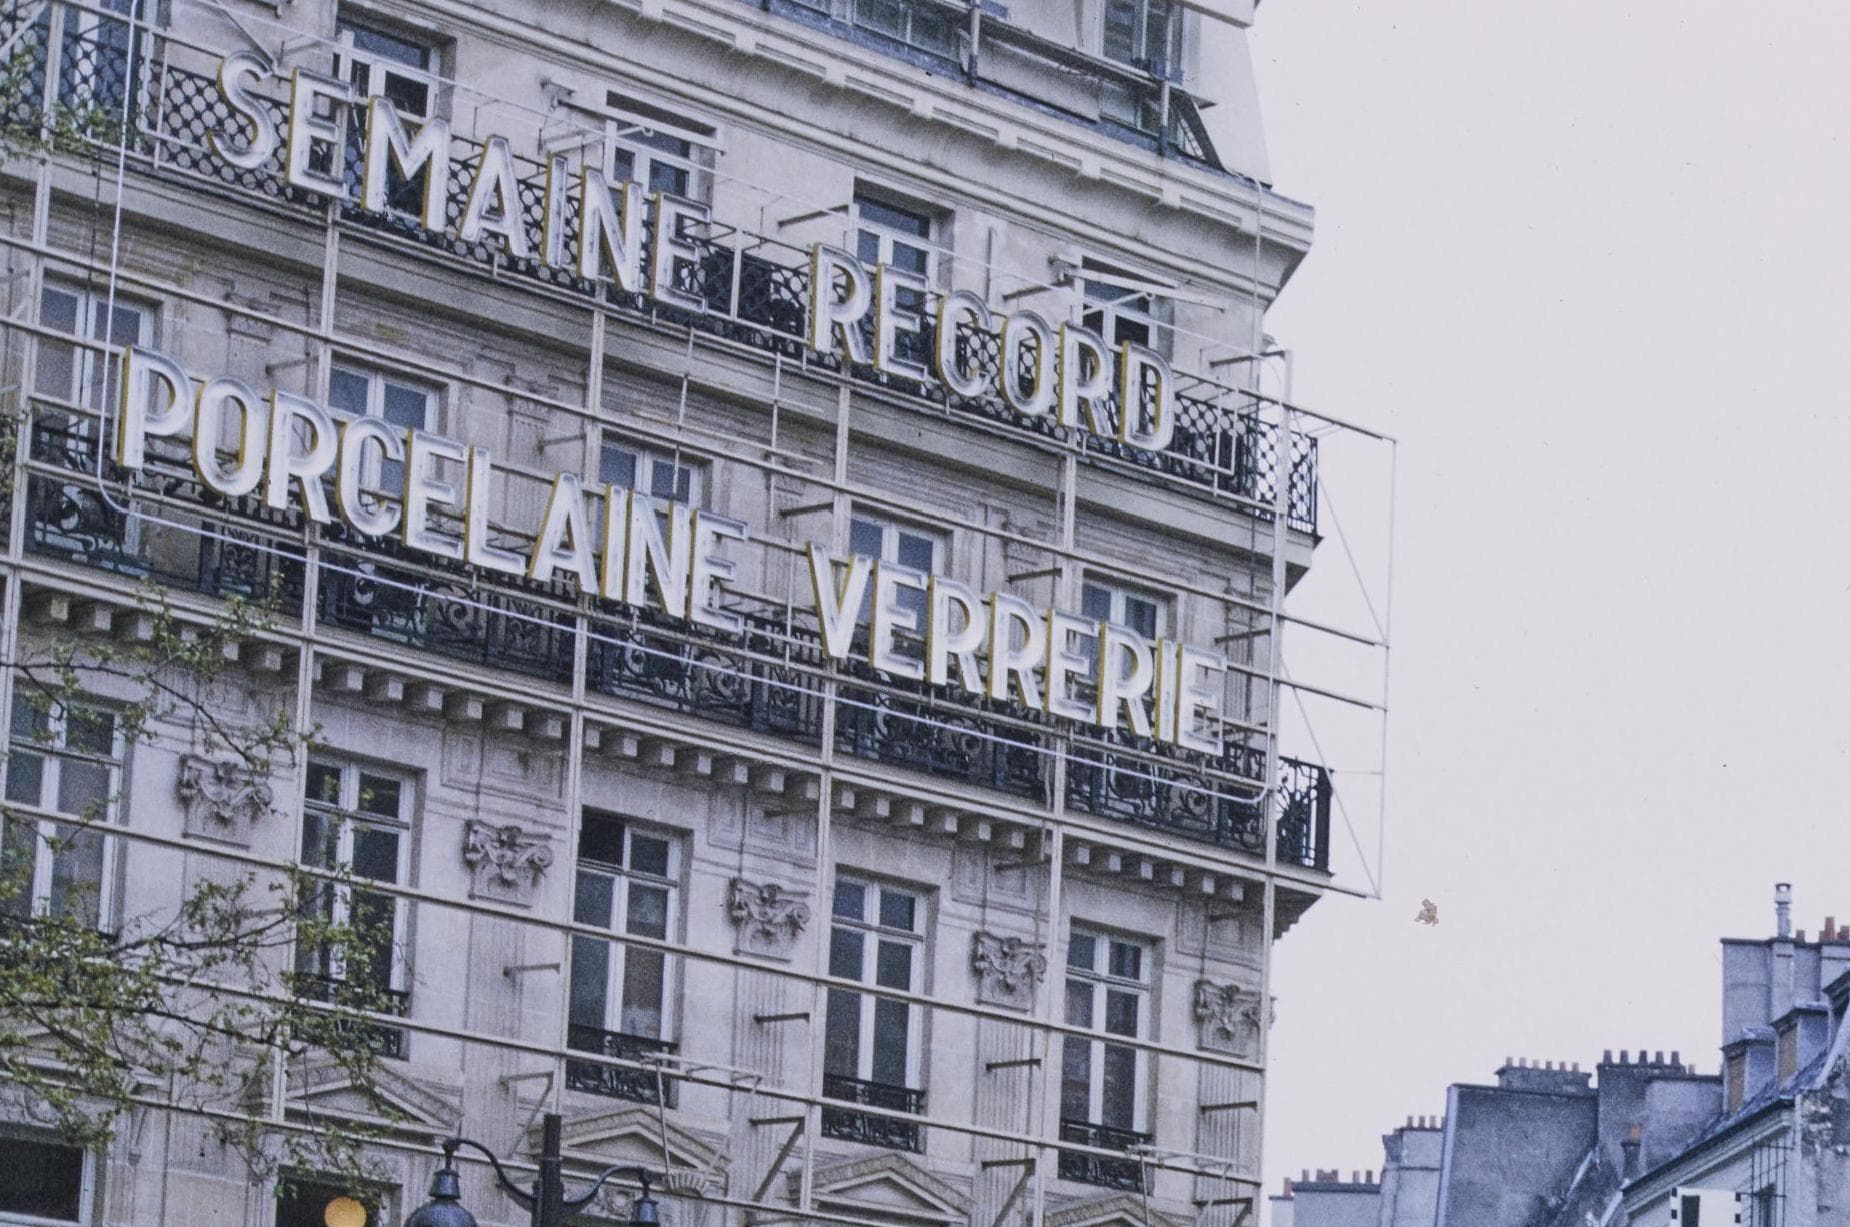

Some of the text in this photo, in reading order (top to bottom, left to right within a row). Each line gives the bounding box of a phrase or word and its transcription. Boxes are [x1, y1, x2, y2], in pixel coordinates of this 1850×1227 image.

[207, 48, 1175, 452] SEMAINE RECORD
[117, 345, 1228, 756] PORCELAINE VERRERIE
